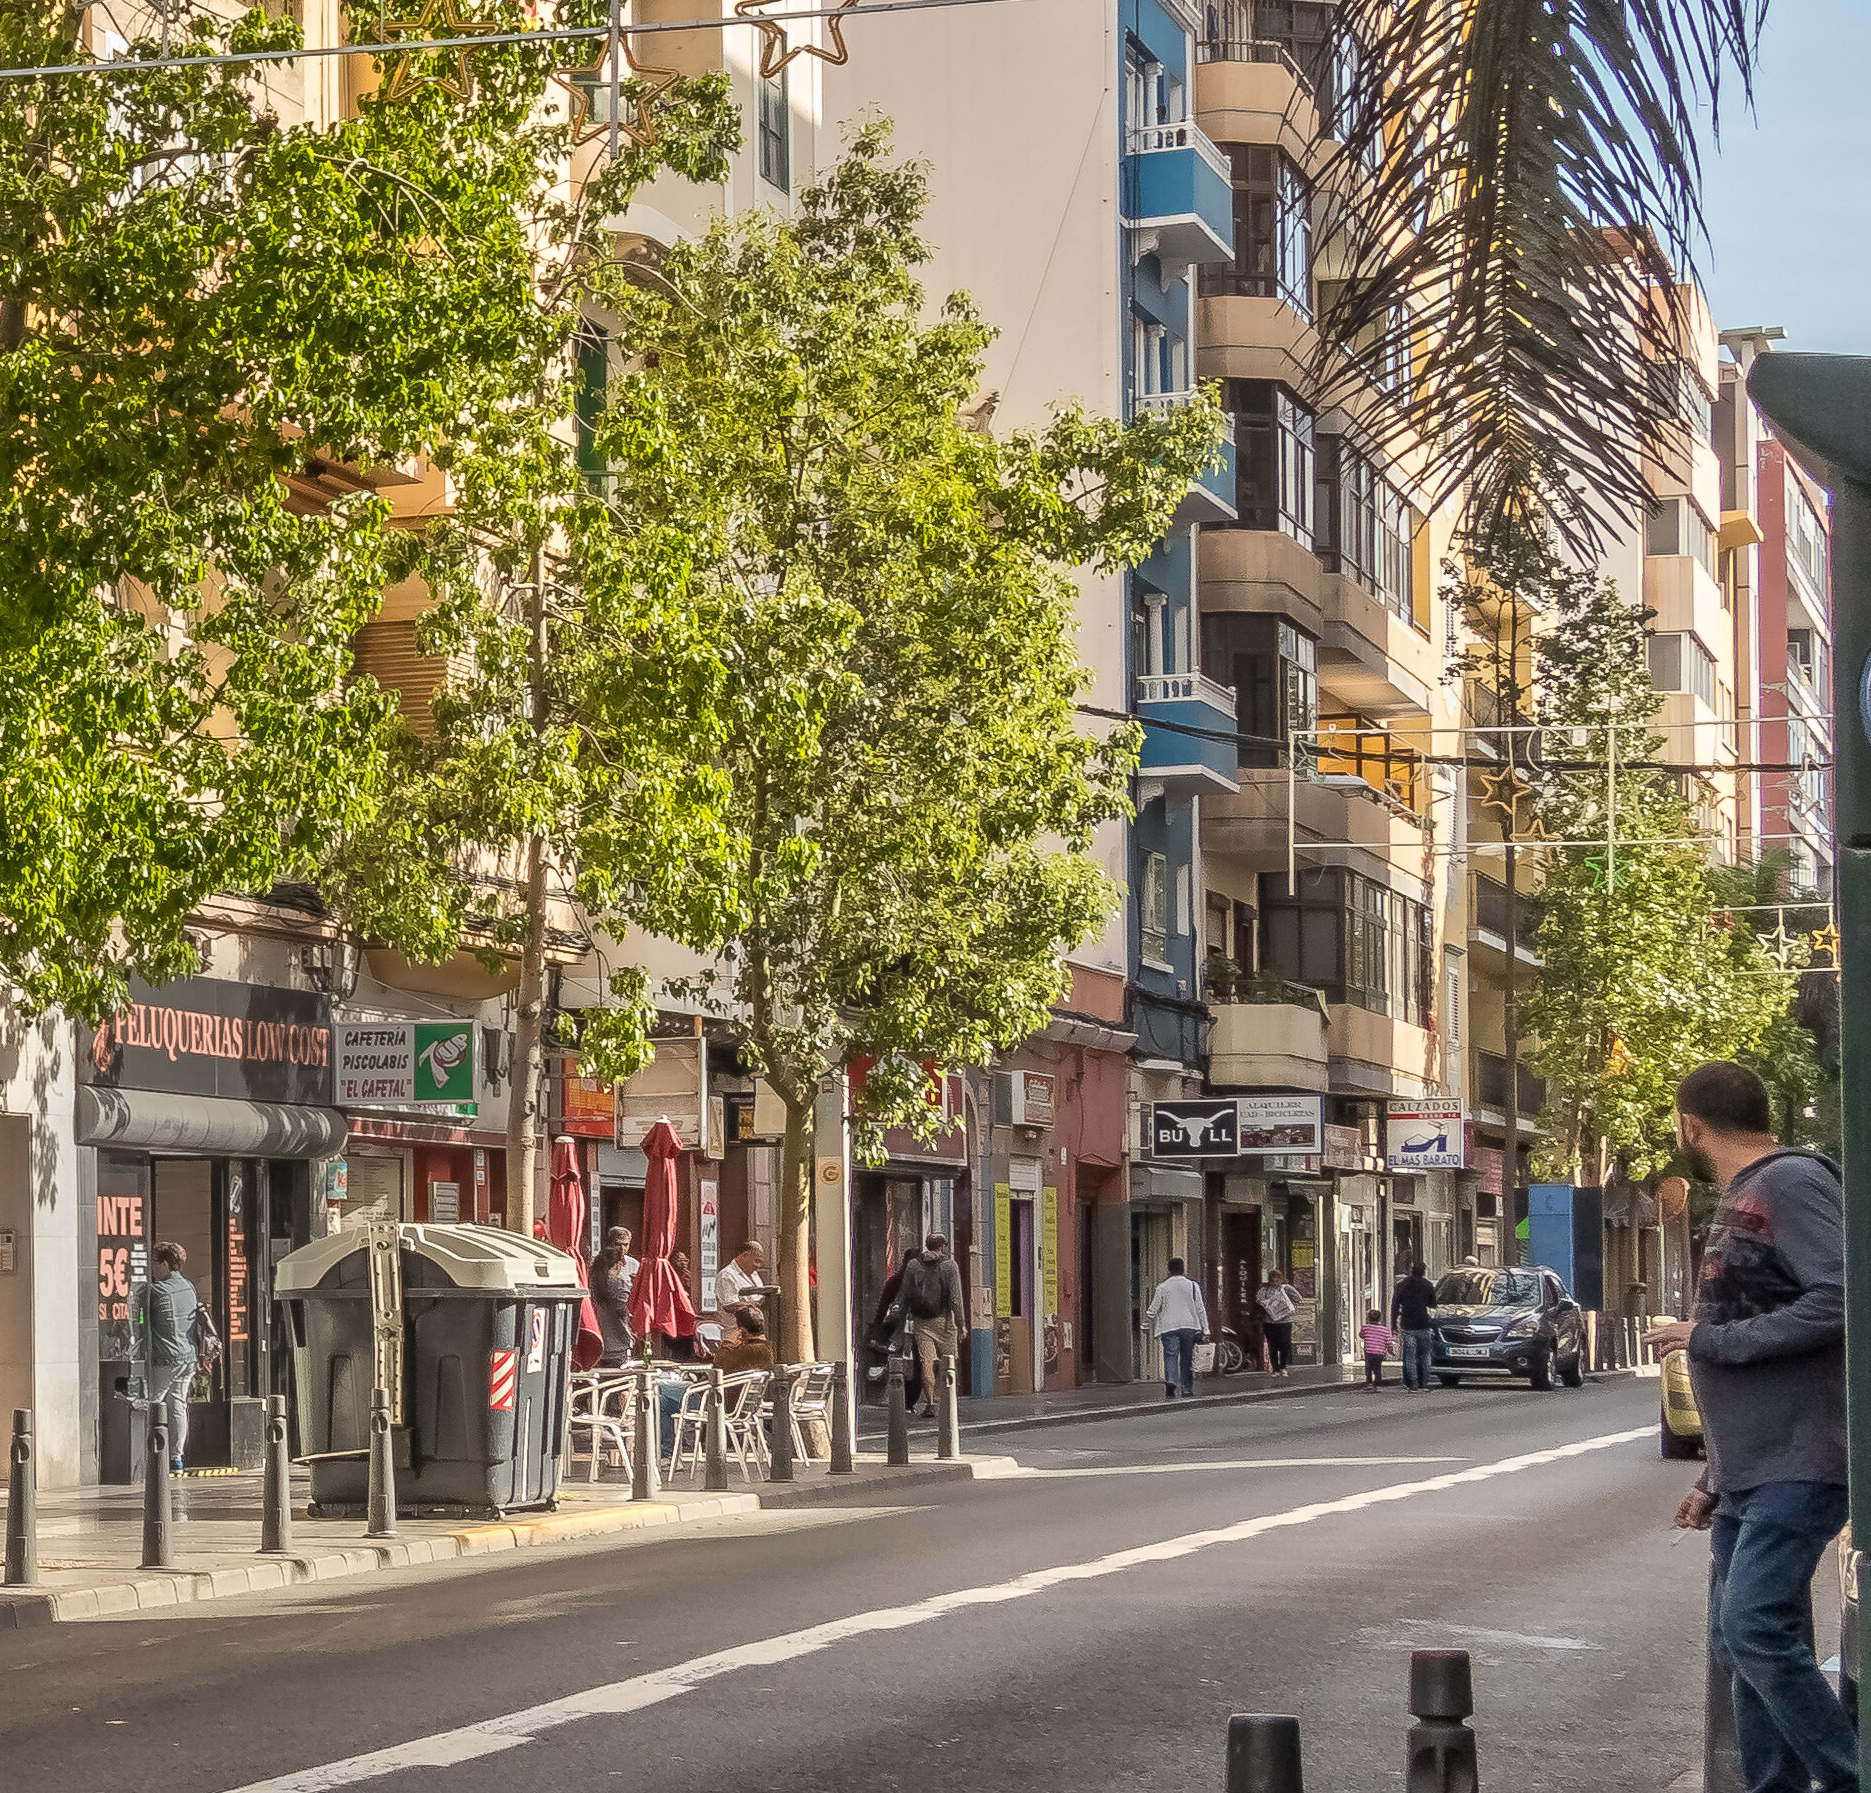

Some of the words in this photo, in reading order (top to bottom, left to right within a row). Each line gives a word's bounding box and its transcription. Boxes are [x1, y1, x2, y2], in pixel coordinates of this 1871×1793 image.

[114, 1003, 243, 1062] PELUQUERIAS
[246, 1020, 285, 1063] LOW
[289, 1023, 331, 1068] COST
[344, 1025, 407, 1047] CAFETERÍA
[342, 1054, 409, 1070] PISCOLABIS
[1246, 1101, 1302, 1109] ALQUILER
[1389, 1102, 1459, 1112] CALZADOS
[1388, 1155, 1398, 1166] EL
[1423, 1154, 1459, 1166] BARATO
